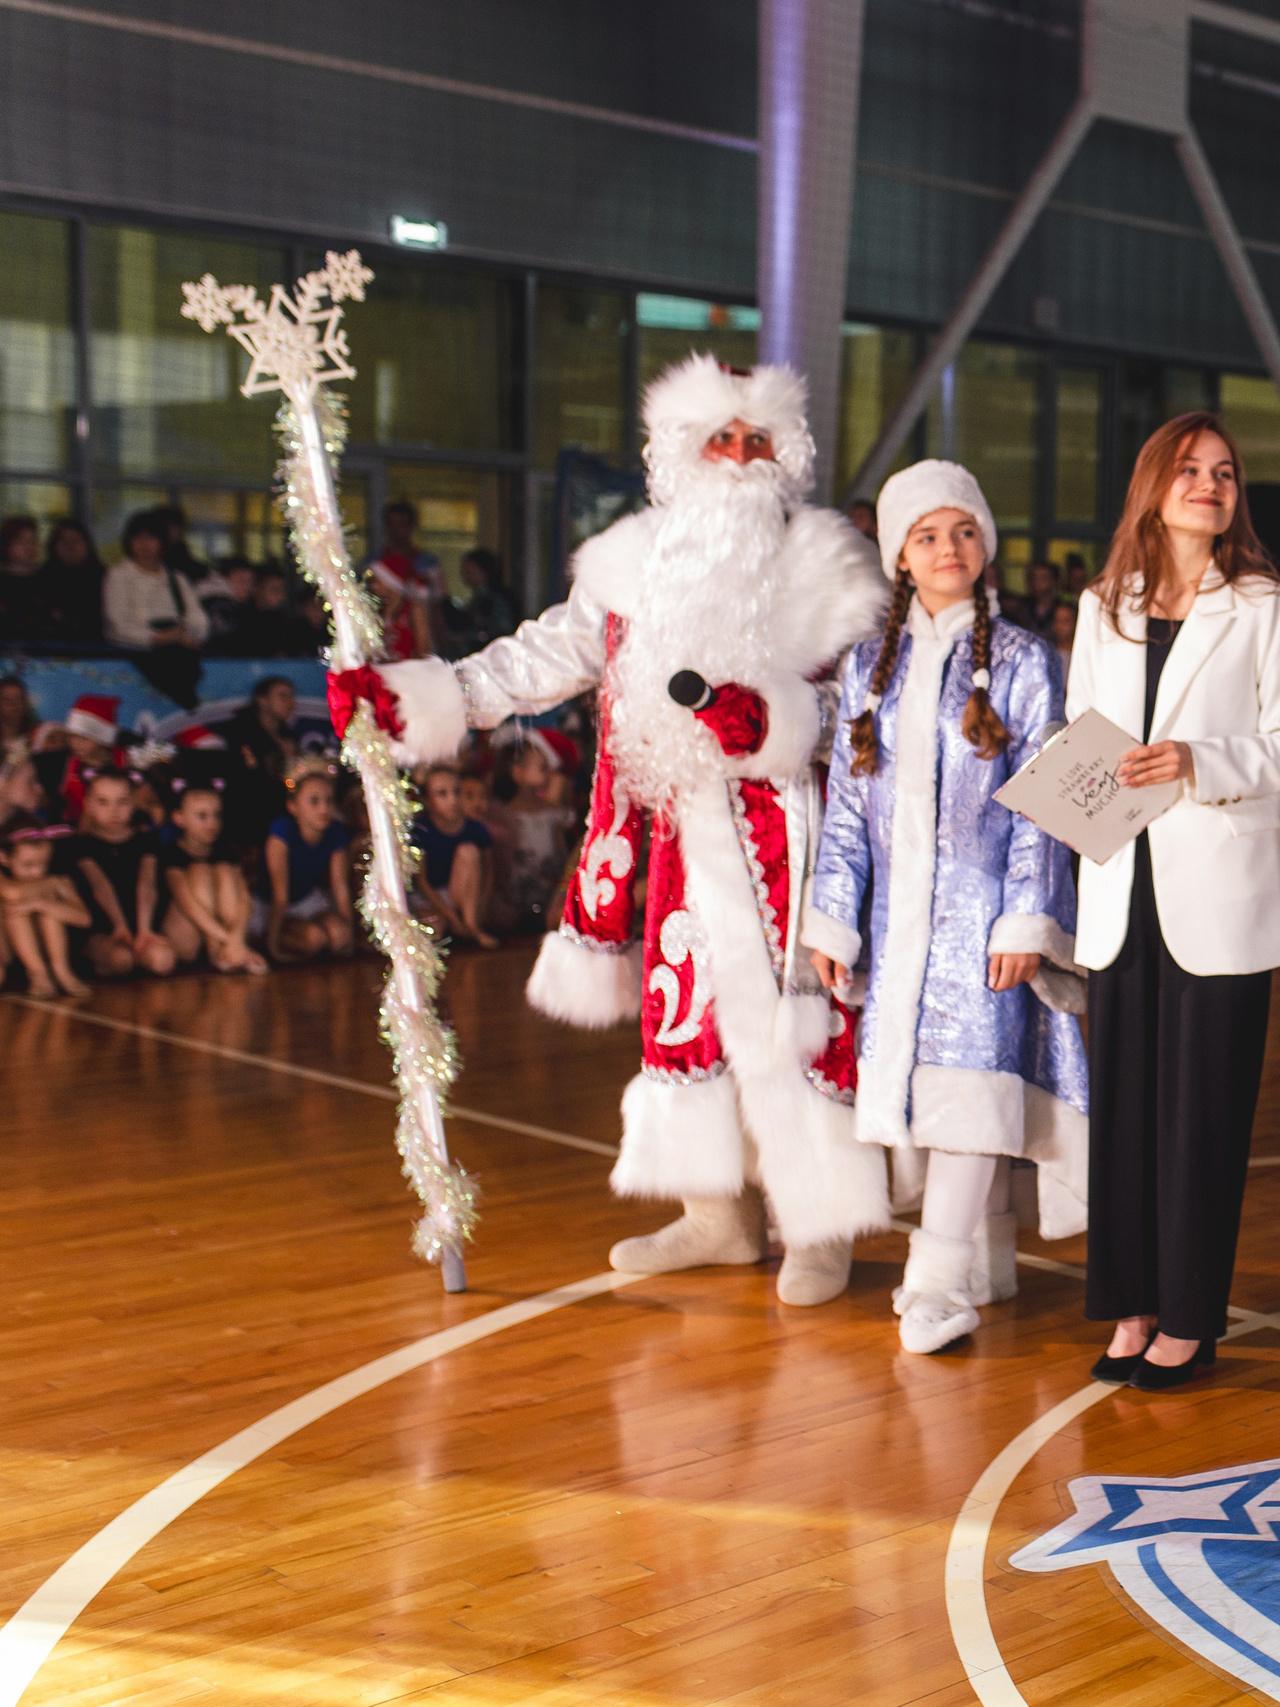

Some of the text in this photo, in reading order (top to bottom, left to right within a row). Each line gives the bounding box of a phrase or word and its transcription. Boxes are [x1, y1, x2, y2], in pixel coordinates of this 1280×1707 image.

[1057, 755, 1105, 800] STRAWBERRY
[1065, 761, 1084, 780] LOVE
[1085, 788, 1117, 820] MUCH
